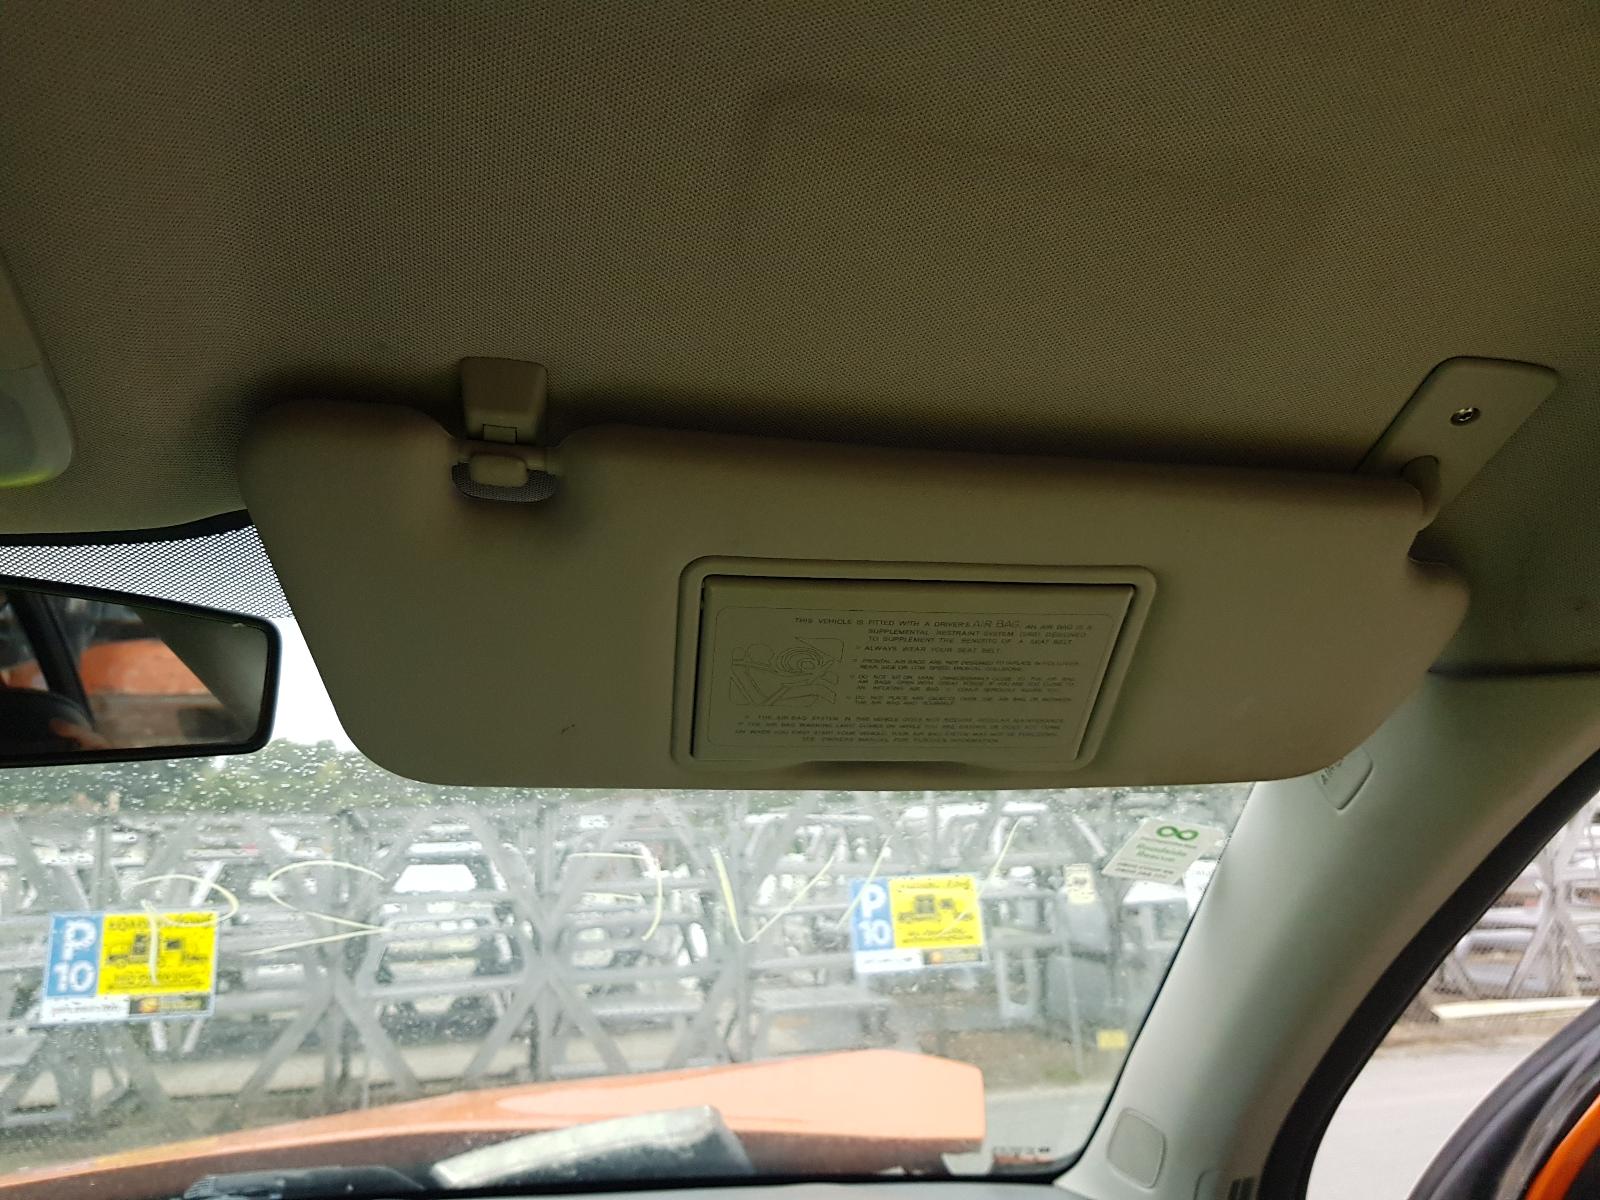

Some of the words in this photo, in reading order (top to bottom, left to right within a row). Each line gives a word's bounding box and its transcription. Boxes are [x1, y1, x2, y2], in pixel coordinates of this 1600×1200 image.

[972, 619, 992, 628] AIR
[860, 883, 886, 918] P
[62, 918, 97, 961] P
[858, 918, 892, 946] 10
[53, 960, 96, 993] 10
